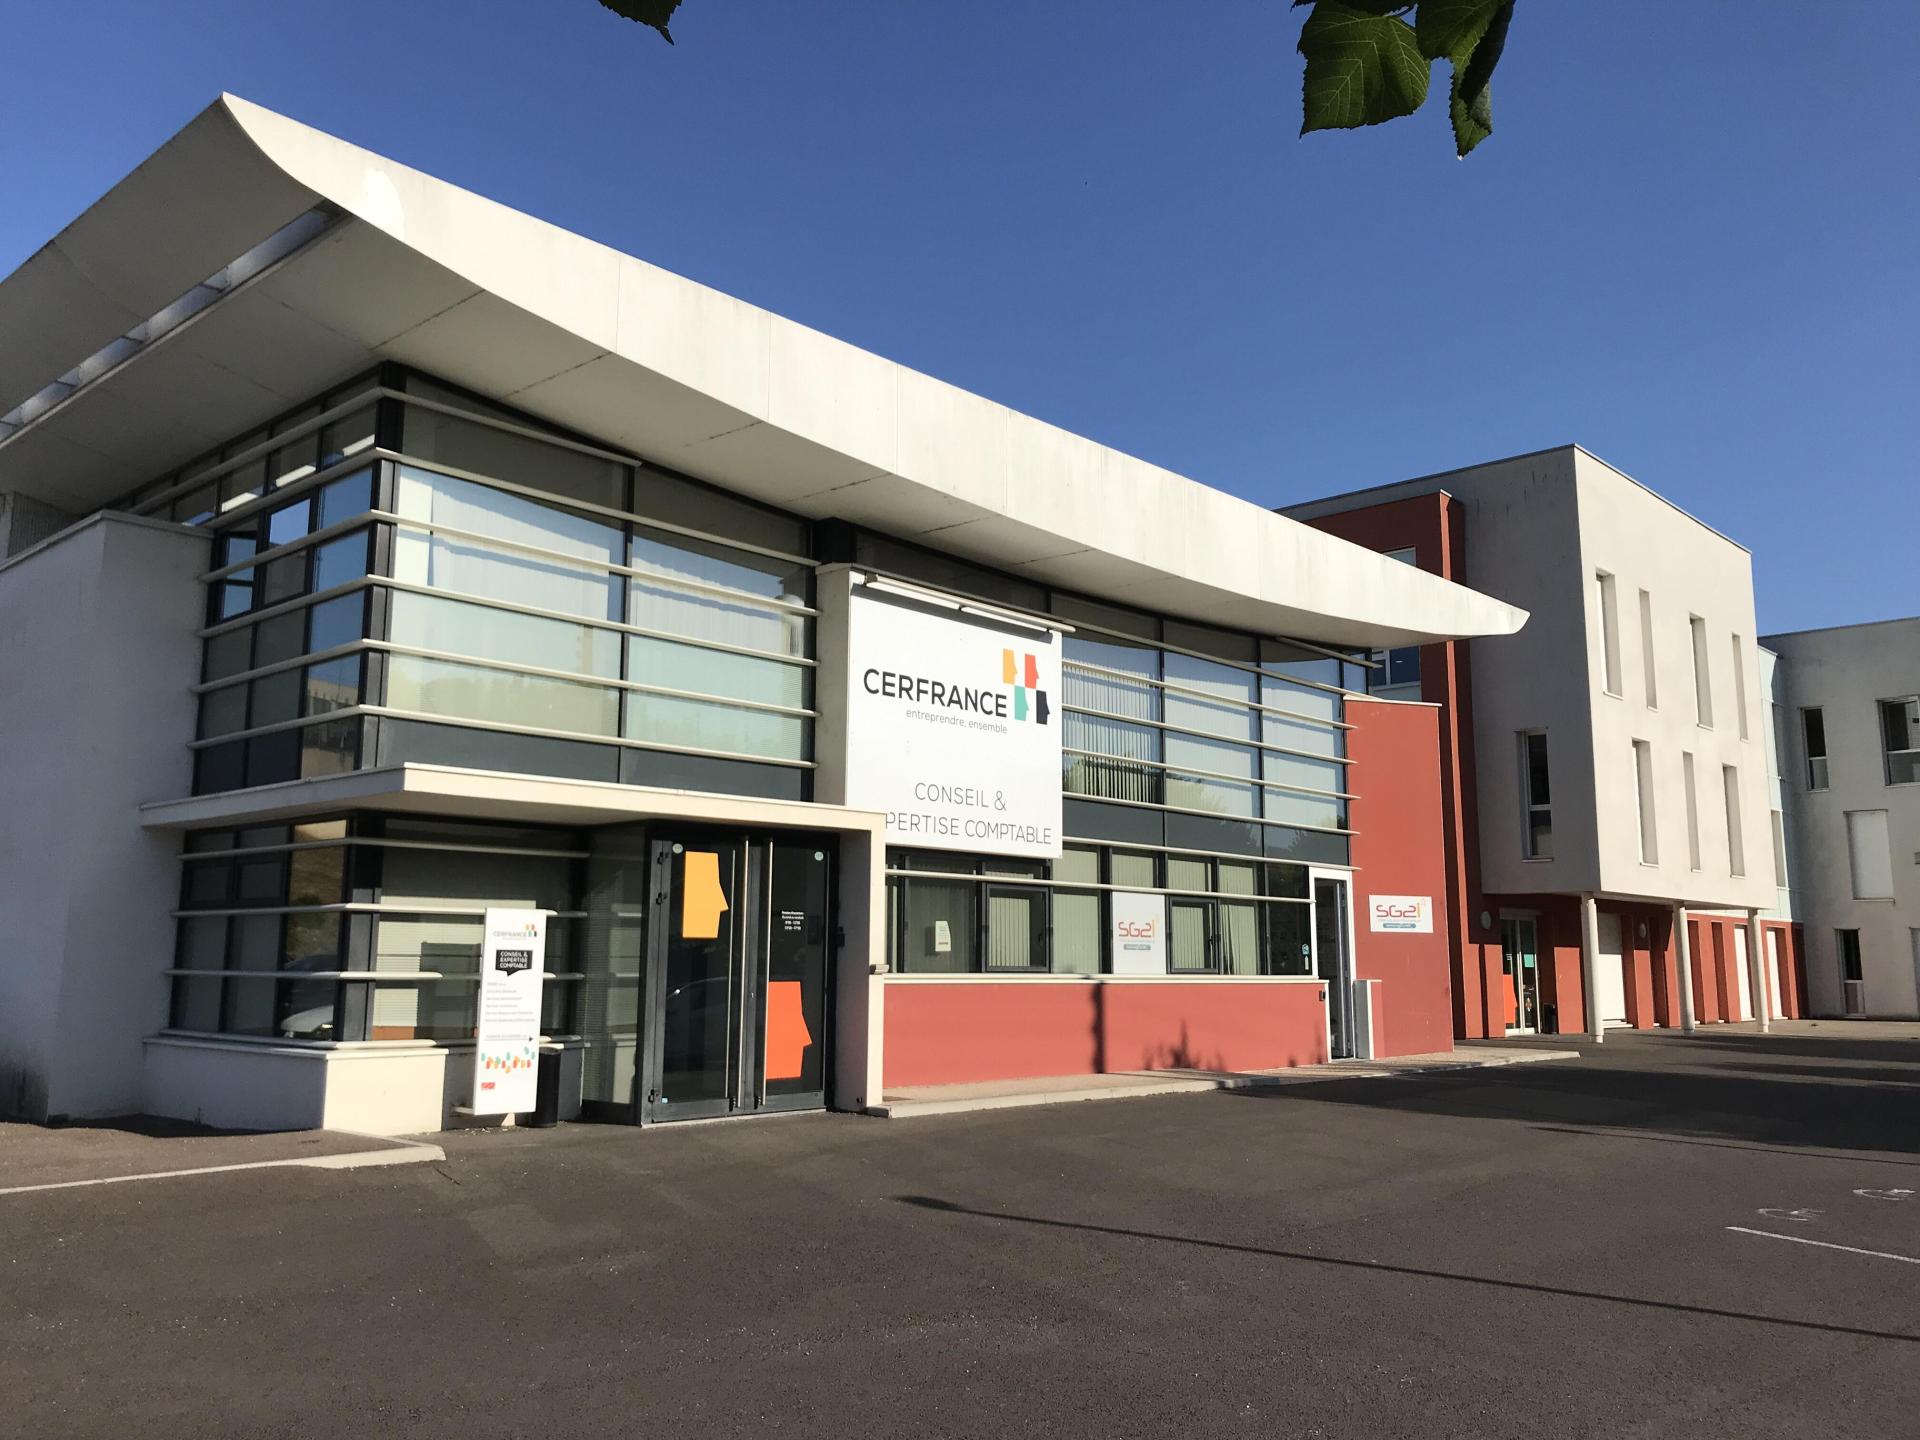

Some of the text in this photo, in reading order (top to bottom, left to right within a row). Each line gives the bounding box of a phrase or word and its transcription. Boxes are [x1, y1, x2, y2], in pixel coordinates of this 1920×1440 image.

[863, 668, 1007, 718] CERFRANCE
[968, 720, 1008, 734] ensemble
[915, 782, 1007, 812] CONSEIL &
[885, 811, 1052, 845] PERTISE COMPTABLE
